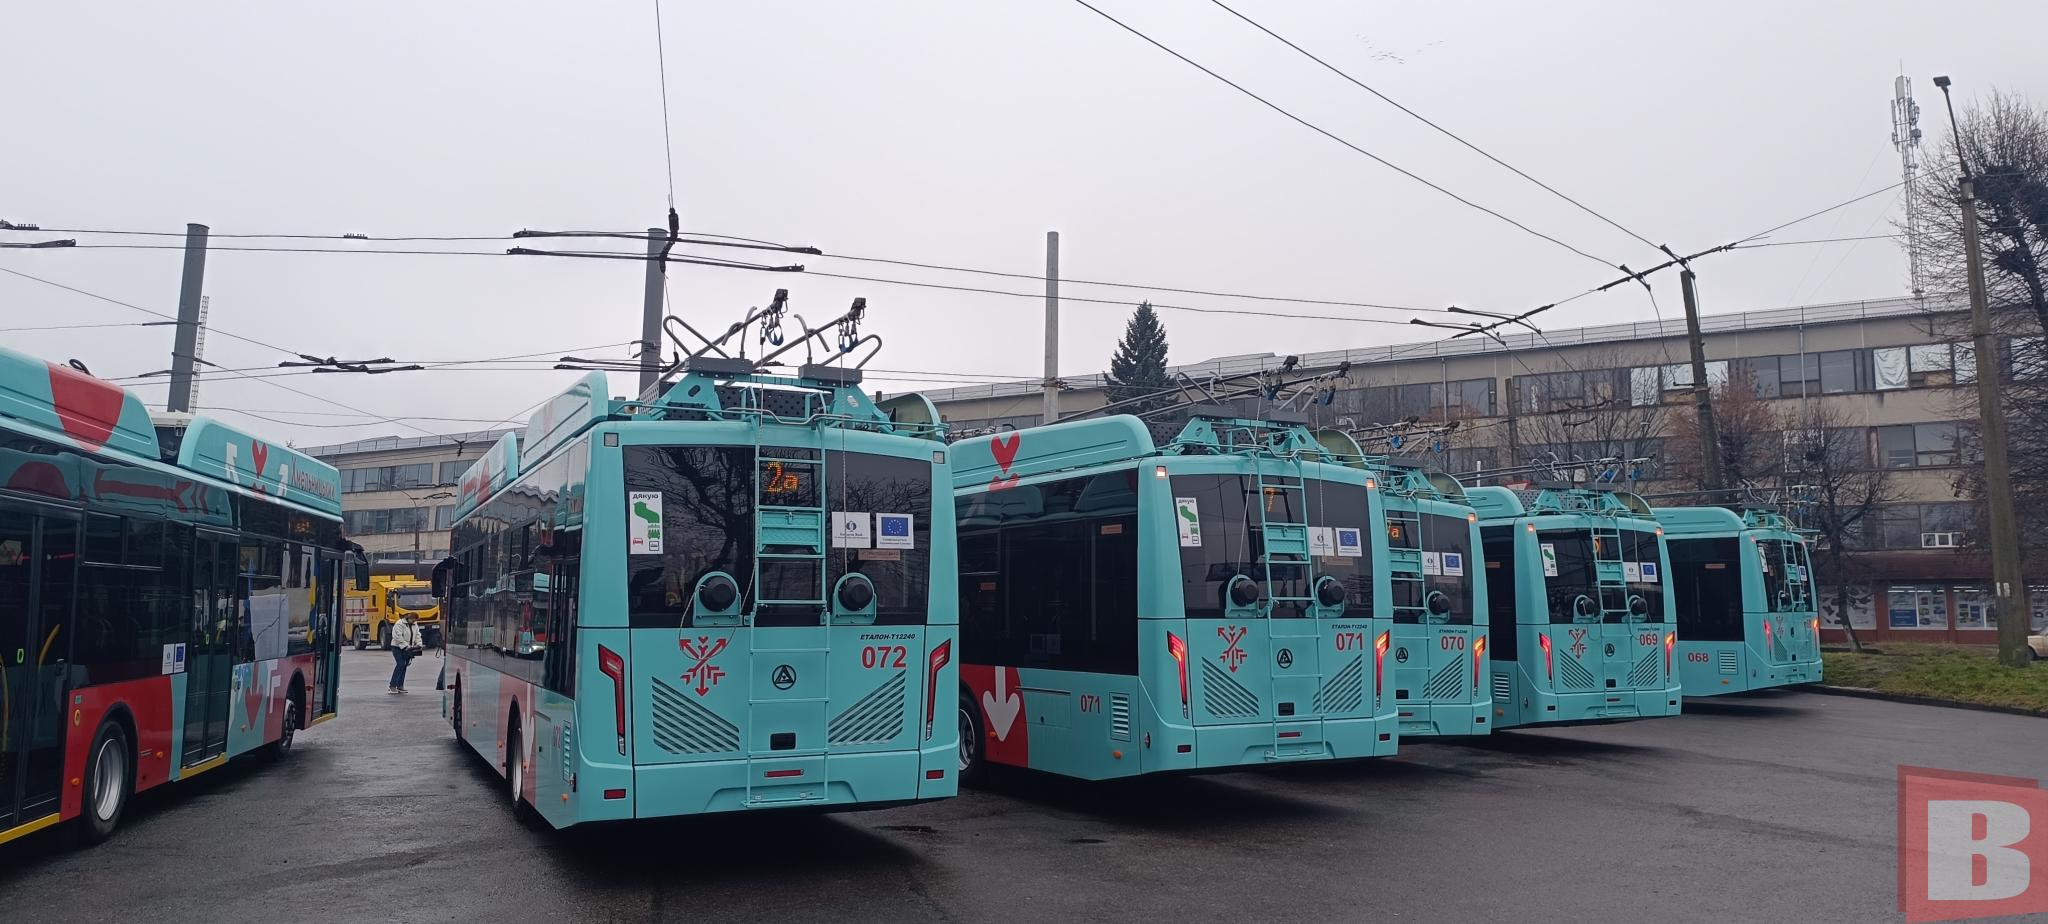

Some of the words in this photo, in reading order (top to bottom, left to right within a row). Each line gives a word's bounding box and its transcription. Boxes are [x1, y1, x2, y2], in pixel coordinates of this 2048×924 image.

[1335, 632, 1364, 651] 071
[1441, 635, 1465, 650] 070
[1640, 633, 1658, 646] 069
[861, 645, 907, 669] 072
[1688, 652, 1710, 663] 068
[1080, 694, 1101, 714] 071
